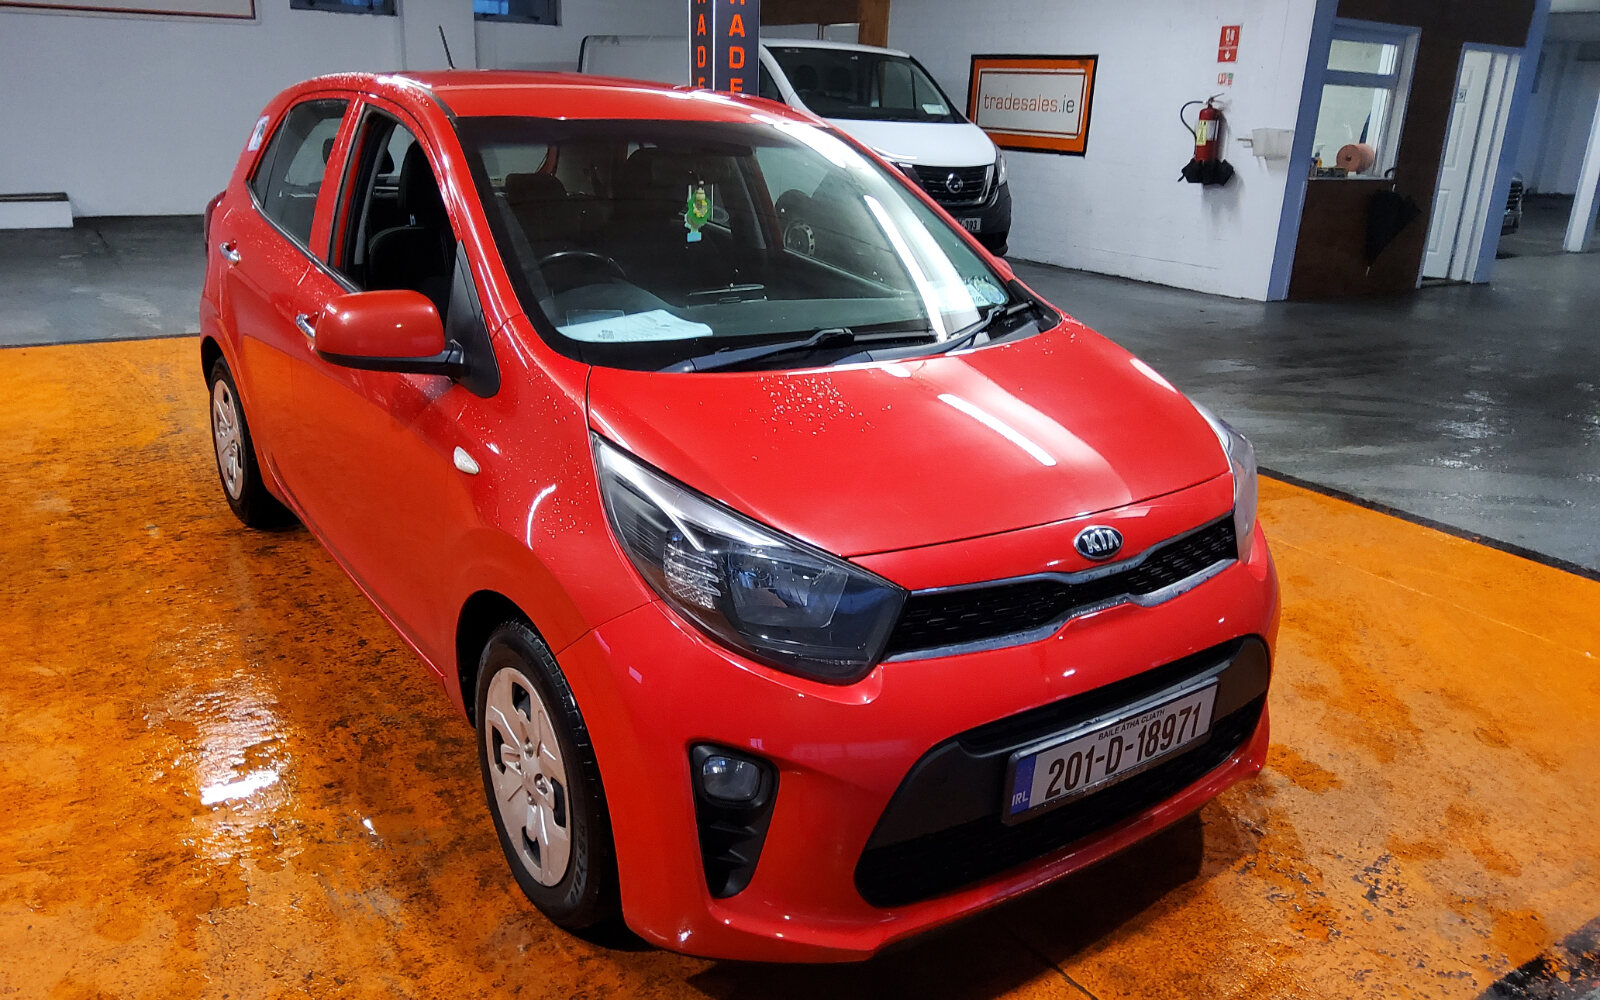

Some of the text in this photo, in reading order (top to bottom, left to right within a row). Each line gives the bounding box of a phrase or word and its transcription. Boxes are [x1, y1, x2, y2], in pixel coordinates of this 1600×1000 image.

[728, 0, 746, 94] ADE
[984, 92, 1075, 114] tradesales.ie
[1082, 529, 1120, 554] KIA
[1098, 726, 1120, 741] BAILE
[1141, 708, 1166, 724] CLIATH
[1045, 702, 1202, 800] 201-D-18971
[1011, 790, 1029, 807] IRL
